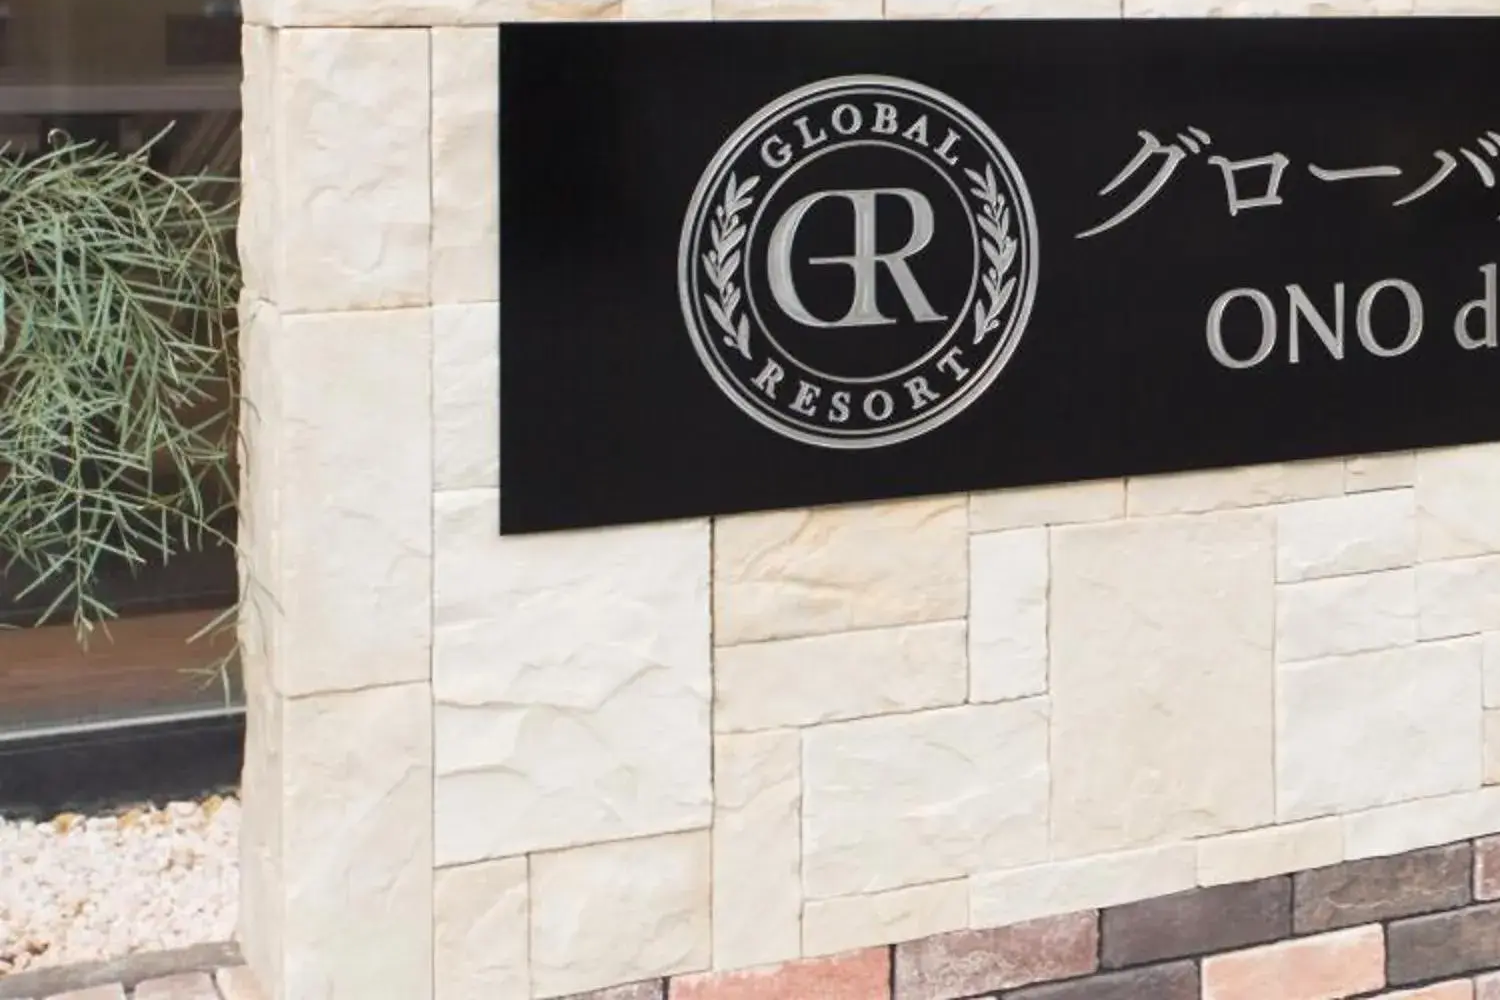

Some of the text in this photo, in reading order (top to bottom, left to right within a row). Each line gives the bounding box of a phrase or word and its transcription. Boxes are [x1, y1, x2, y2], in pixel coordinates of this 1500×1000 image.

[760, 102, 961, 169] GLOBAL
[1205, 278, 1424, 369] ONO
[751, 346, 971, 423] RESORT
